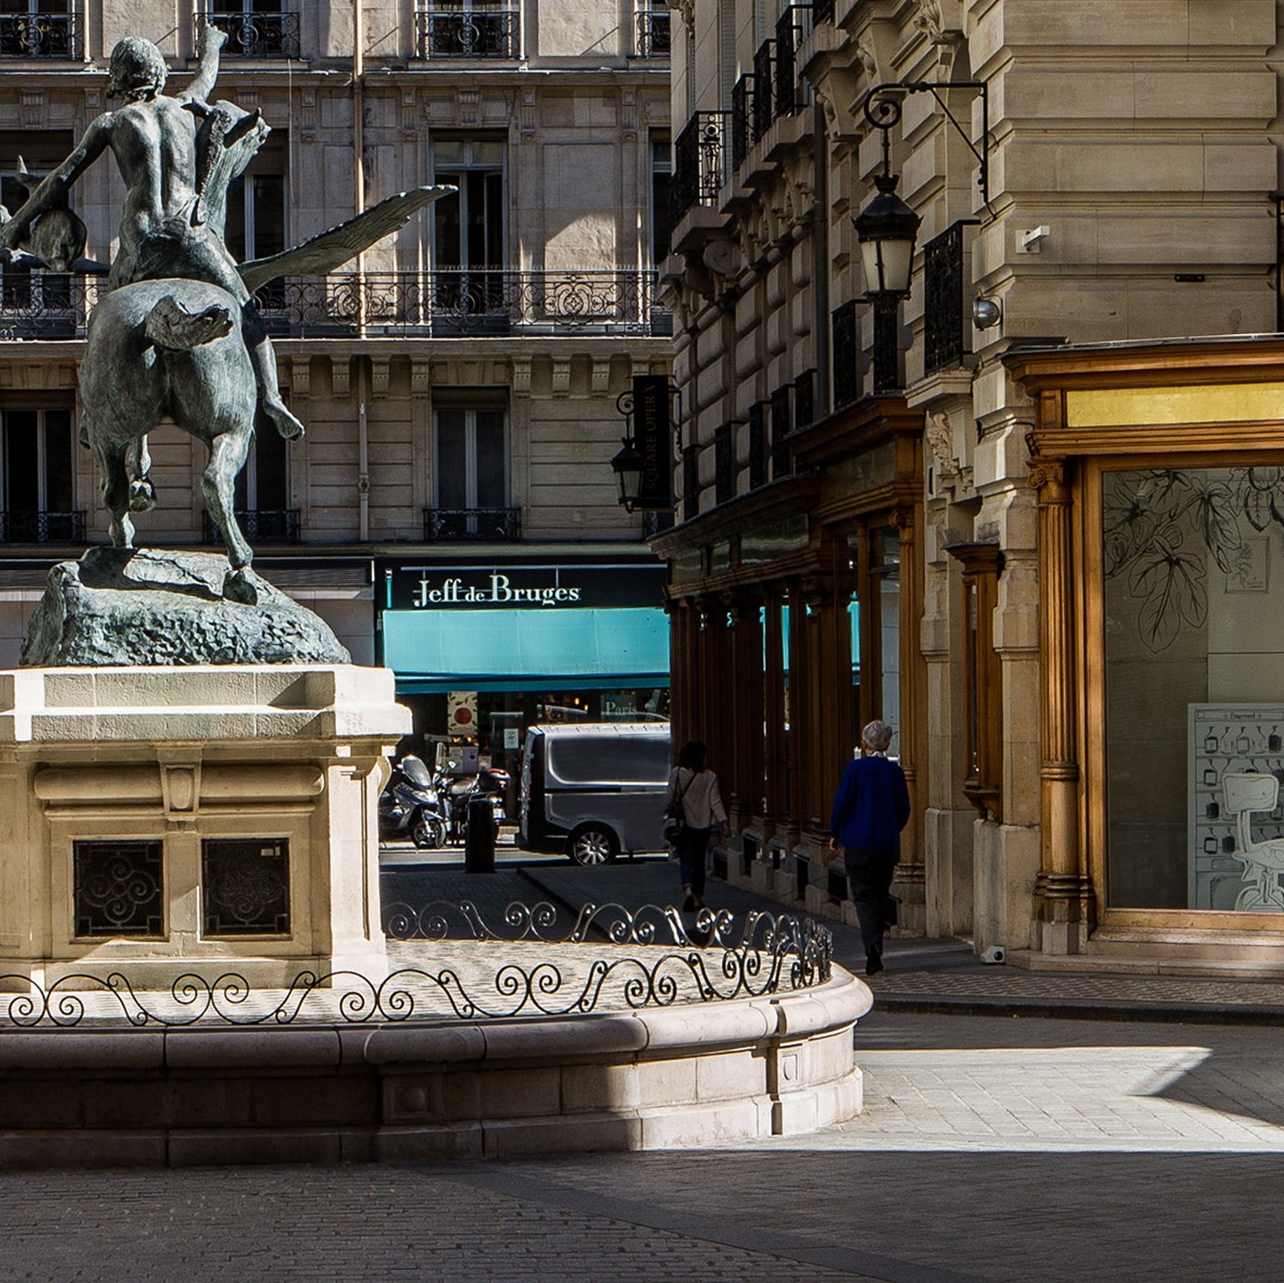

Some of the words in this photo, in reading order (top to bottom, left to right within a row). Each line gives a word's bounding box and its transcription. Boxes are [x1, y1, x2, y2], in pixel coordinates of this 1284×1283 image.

[645, 384, 657, 432] OPERA
[644, 434, 659, 490] SQUARE
[413, 578, 462, 607] Jeff
[465, 586, 485, 602] de
[489, 574, 580, 606] Bruges
[605, 701, 637, 715] Paris
